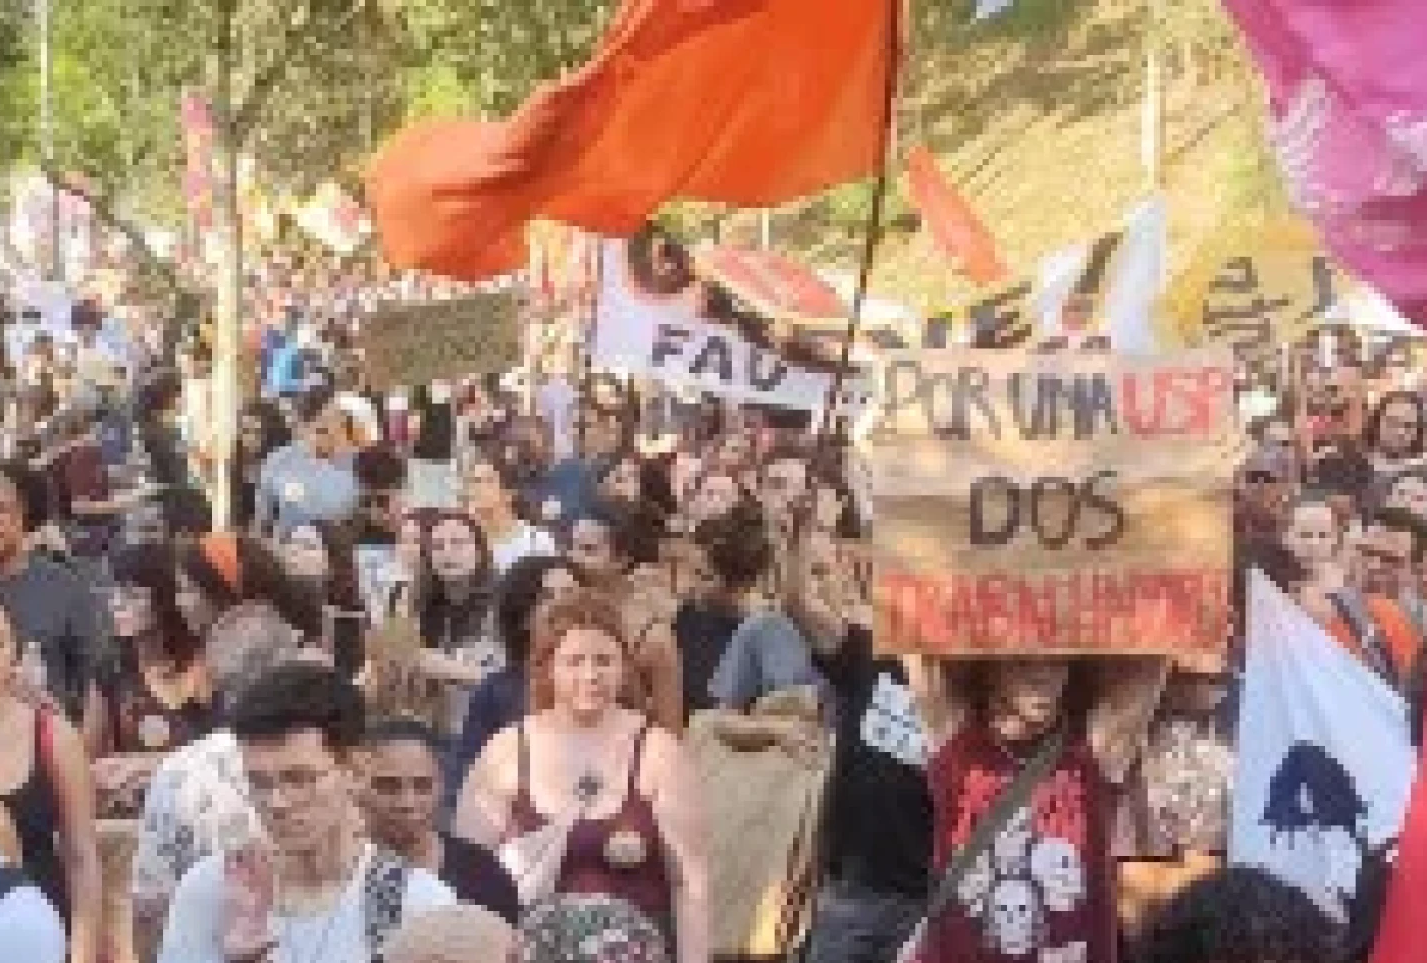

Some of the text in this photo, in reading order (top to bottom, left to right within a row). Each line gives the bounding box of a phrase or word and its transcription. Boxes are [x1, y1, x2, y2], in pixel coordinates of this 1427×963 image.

[883, 360, 1233, 441] POR UMA USP
[969, 470, 1125, 550] DOS
